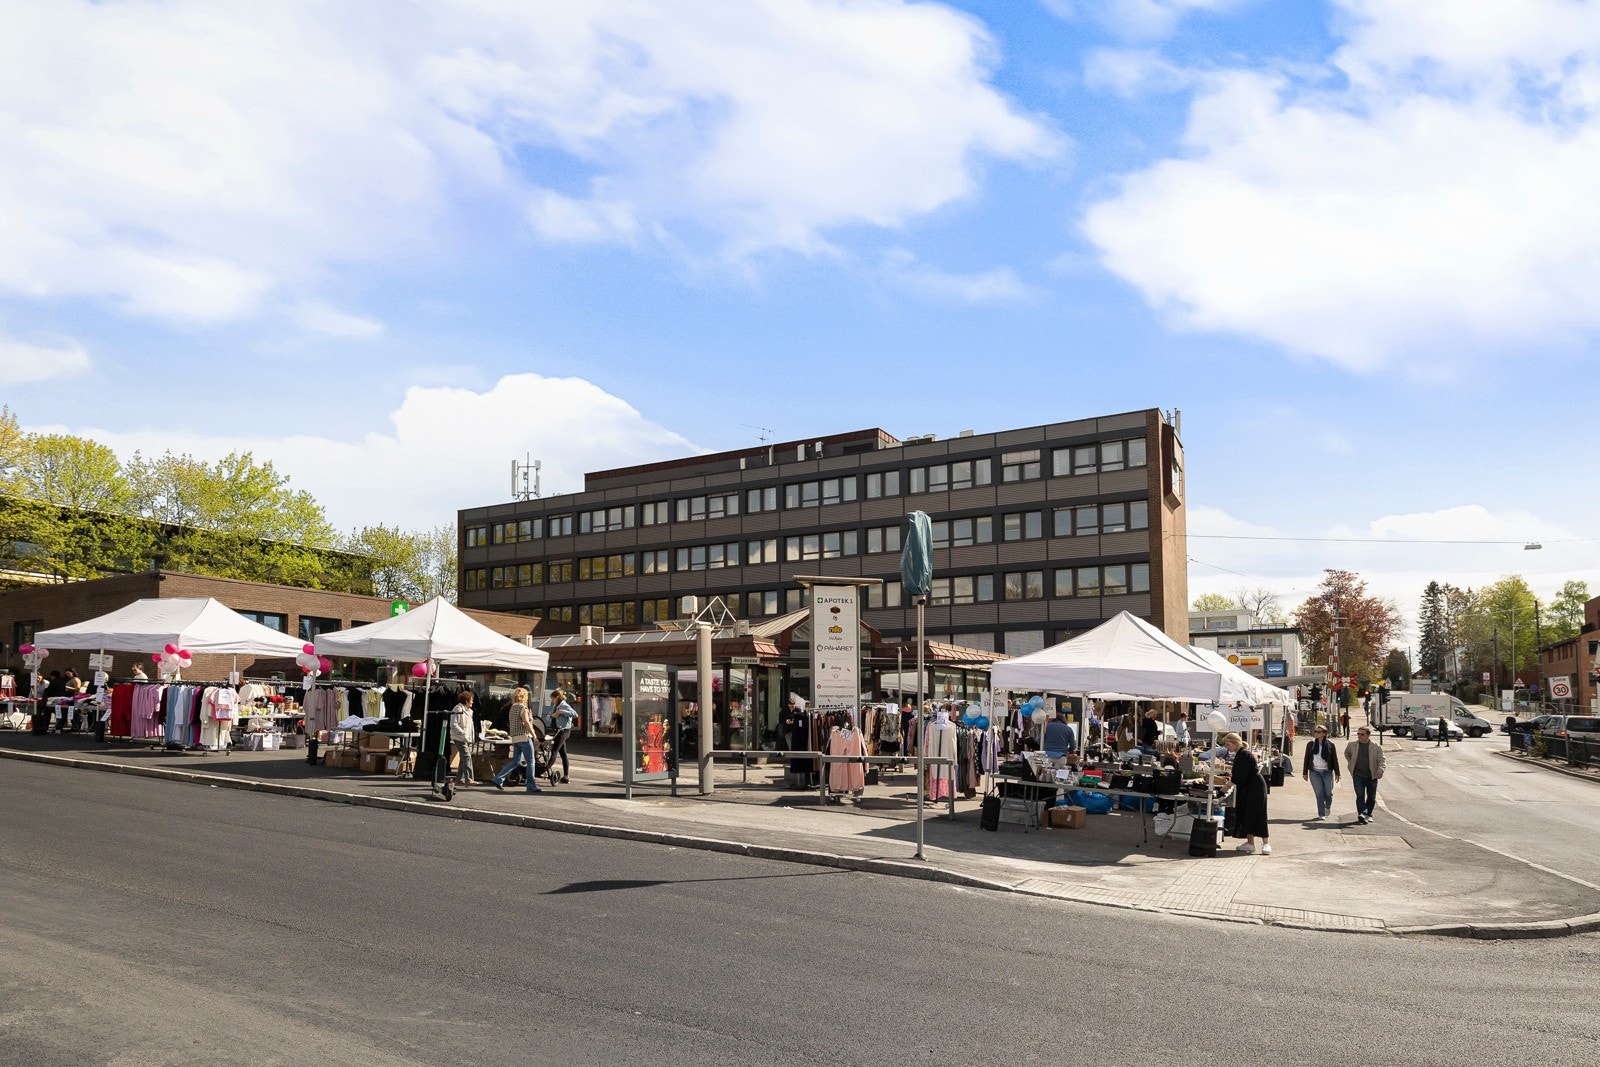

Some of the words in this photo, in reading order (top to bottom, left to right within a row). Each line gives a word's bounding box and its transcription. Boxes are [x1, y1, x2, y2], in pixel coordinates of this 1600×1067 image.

[645, 678, 660, 686] TASTE
[660, 679, 671, 687] YOU
[640, 685, 654, 693] HAVE
